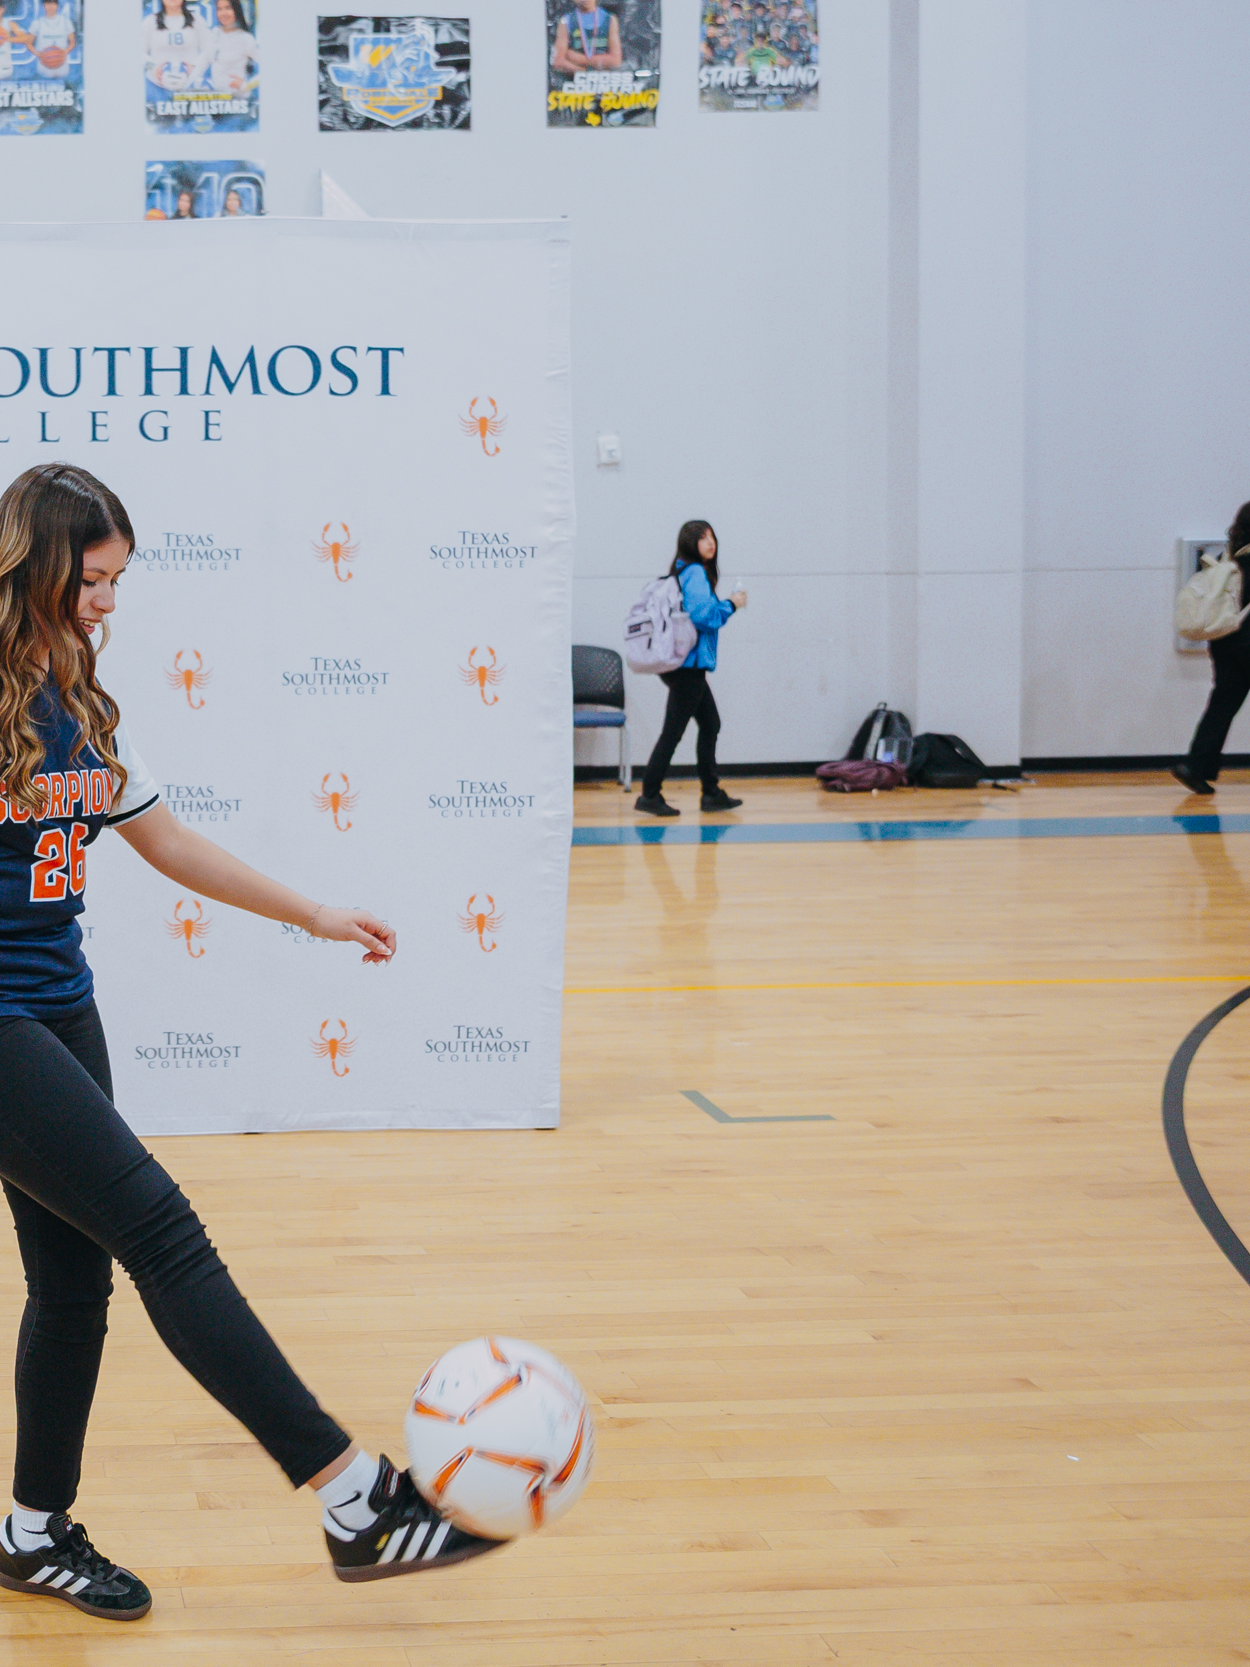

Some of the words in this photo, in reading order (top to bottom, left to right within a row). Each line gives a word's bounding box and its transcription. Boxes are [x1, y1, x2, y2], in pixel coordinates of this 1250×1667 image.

[698, 65, 751, 88] STATE
[755, 64, 822, 87] BOUND
[11, 89, 74, 107] ALLSTARS
[547, 91, 596, 112] STATE
[599, 88, 659, 112] BOUND
[156, 101, 189, 115] EAST
[190, 100, 249, 115] ALLSTARS
[162, 532, 214, 547] TEXAS
[458, 530, 510, 545] TEXAS
[134, 547, 242, 562] SOUTHMOST
[429, 544, 538, 560] SOUTHMOST
[146, 562, 229, 571] COLLEGE
[442, 559, 525, 569] COLLEGE
[310, 656, 362, 672] TEXAS
[282, 671, 390, 686] SOUTHMOST
[294, 686, 377, 695] COLLEGE
[162, 784, 214, 799] TEXAS
[456, 779, 508, 795] TEXAS
[165, 799, 242, 813] THMOST
[428, 794, 535, 809] SOUTHMOST
[440, 809, 523, 818] COLLEGE
[30, 821, 88, 902] 26
[162, 1031, 214, 1046] TEXAS
[453, 1025, 504, 1040] TEXAS
[134, 1045, 242, 1061] SOUTHMOST
[424, 1039, 531, 1054] SOUTHMOST
[147, 1059, 230, 1069] COLLEGE
[437, 1054, 519, 1063] COLLEGE
